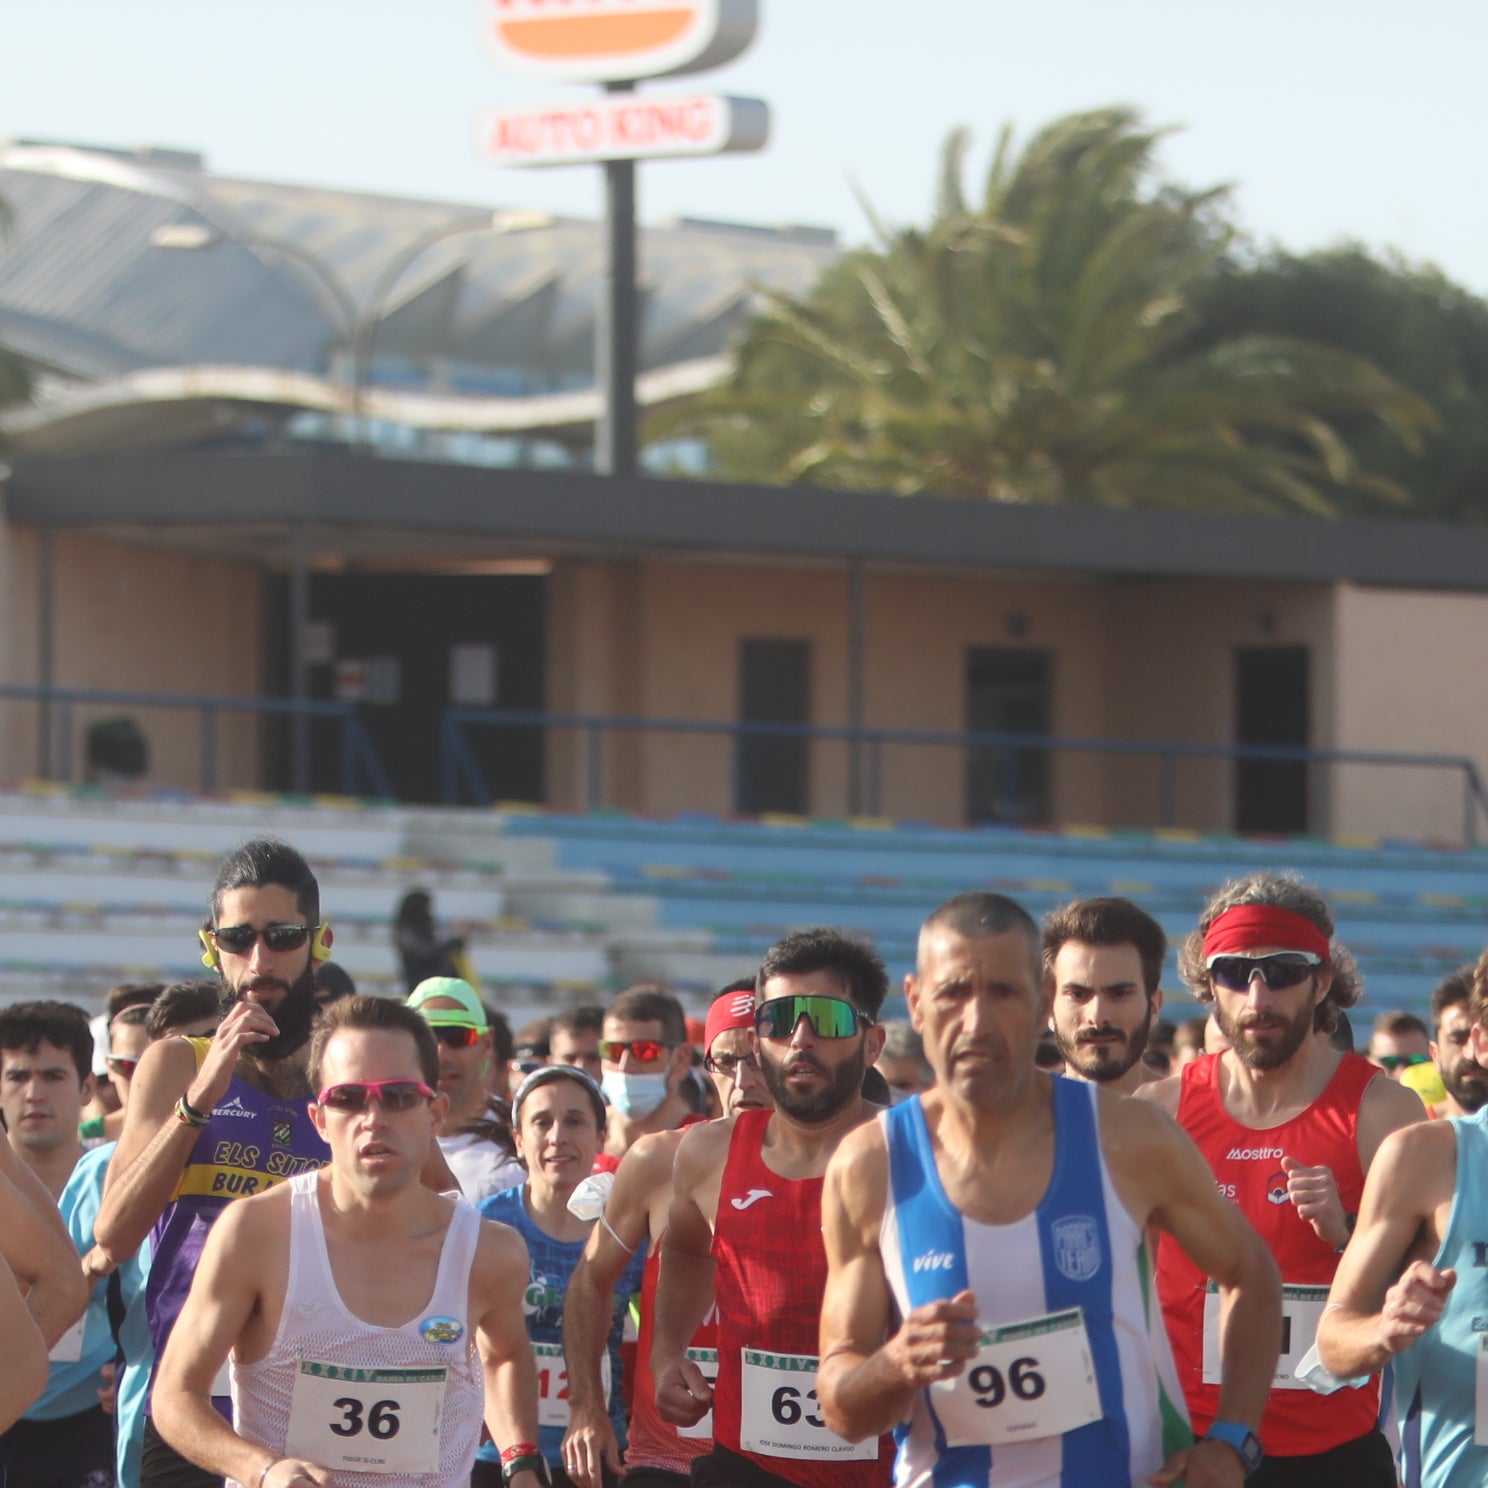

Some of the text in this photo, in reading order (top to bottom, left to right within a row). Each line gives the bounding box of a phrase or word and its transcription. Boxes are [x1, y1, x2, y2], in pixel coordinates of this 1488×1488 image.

[490, 98, 714, 156] AUTO KING
[214, 1141, 261, 1169] ELS
[301, 1361, 377, 1382] XXXIV
[745, 1350, 810, 1371] XXXIV
[968, 1356, 1046, 1409] 96
[329, 1397, 401, 1440] 36
[772, 1441, 802, 1450] DOMINGO
[803, 1444, 830, 1452] ROMERO
